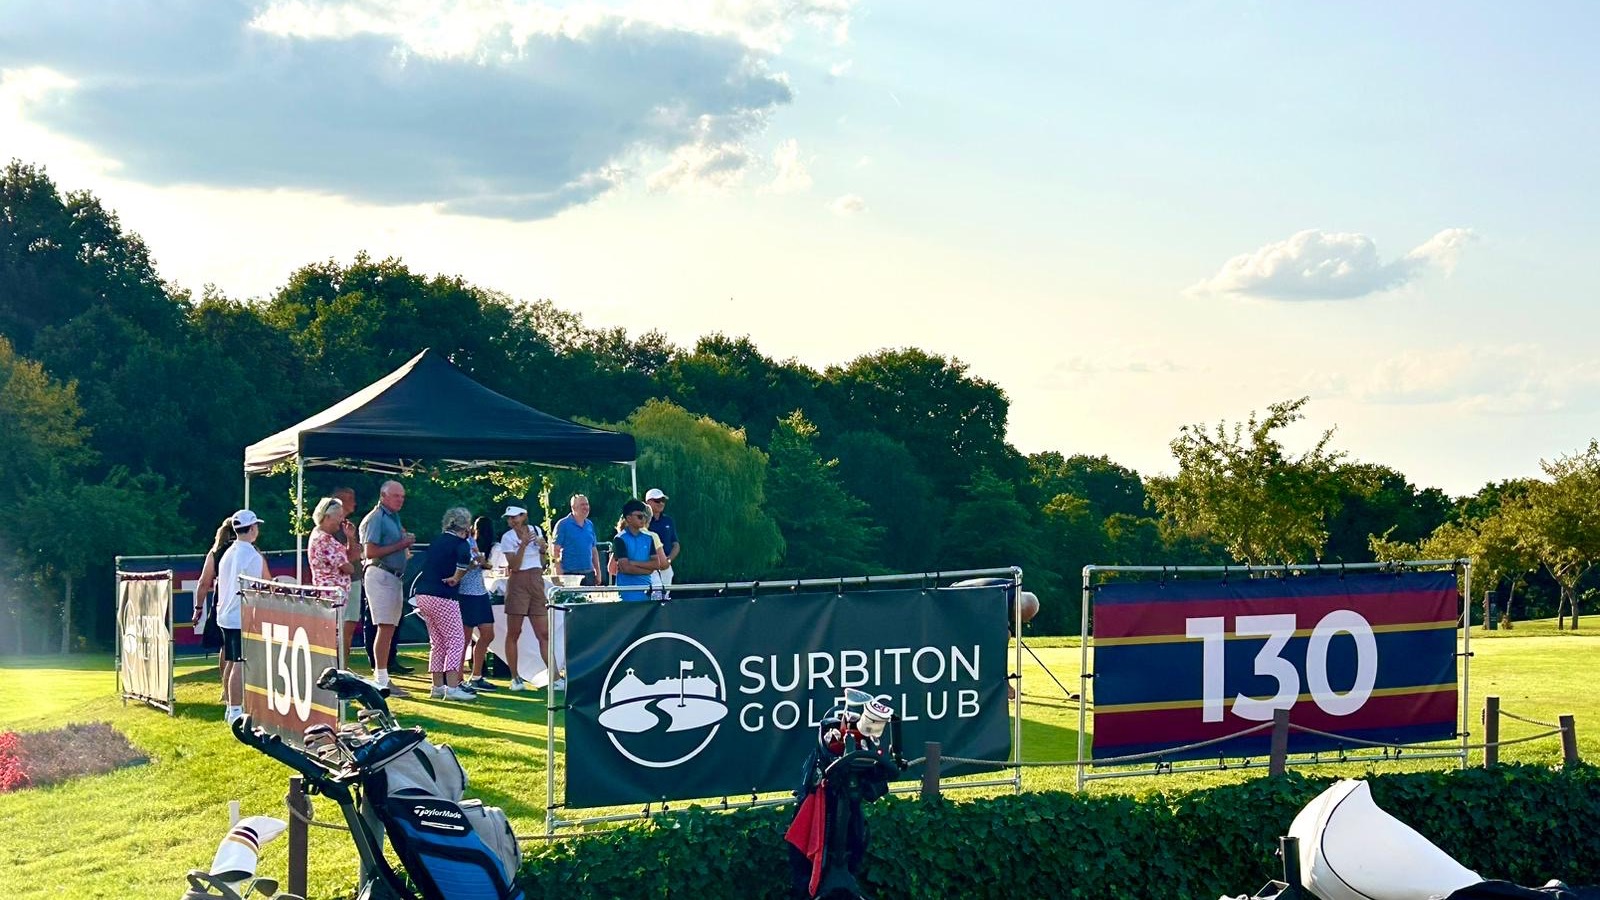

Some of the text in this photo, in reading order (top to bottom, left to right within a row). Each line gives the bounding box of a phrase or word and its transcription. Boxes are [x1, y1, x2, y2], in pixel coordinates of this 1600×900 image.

[261, 621, 313, 722] 130
[738, 644, 981, 695] SURBITON
[1184, 608, 1378, 723] 130
[413, 805, 462, 819] TaylorMade
